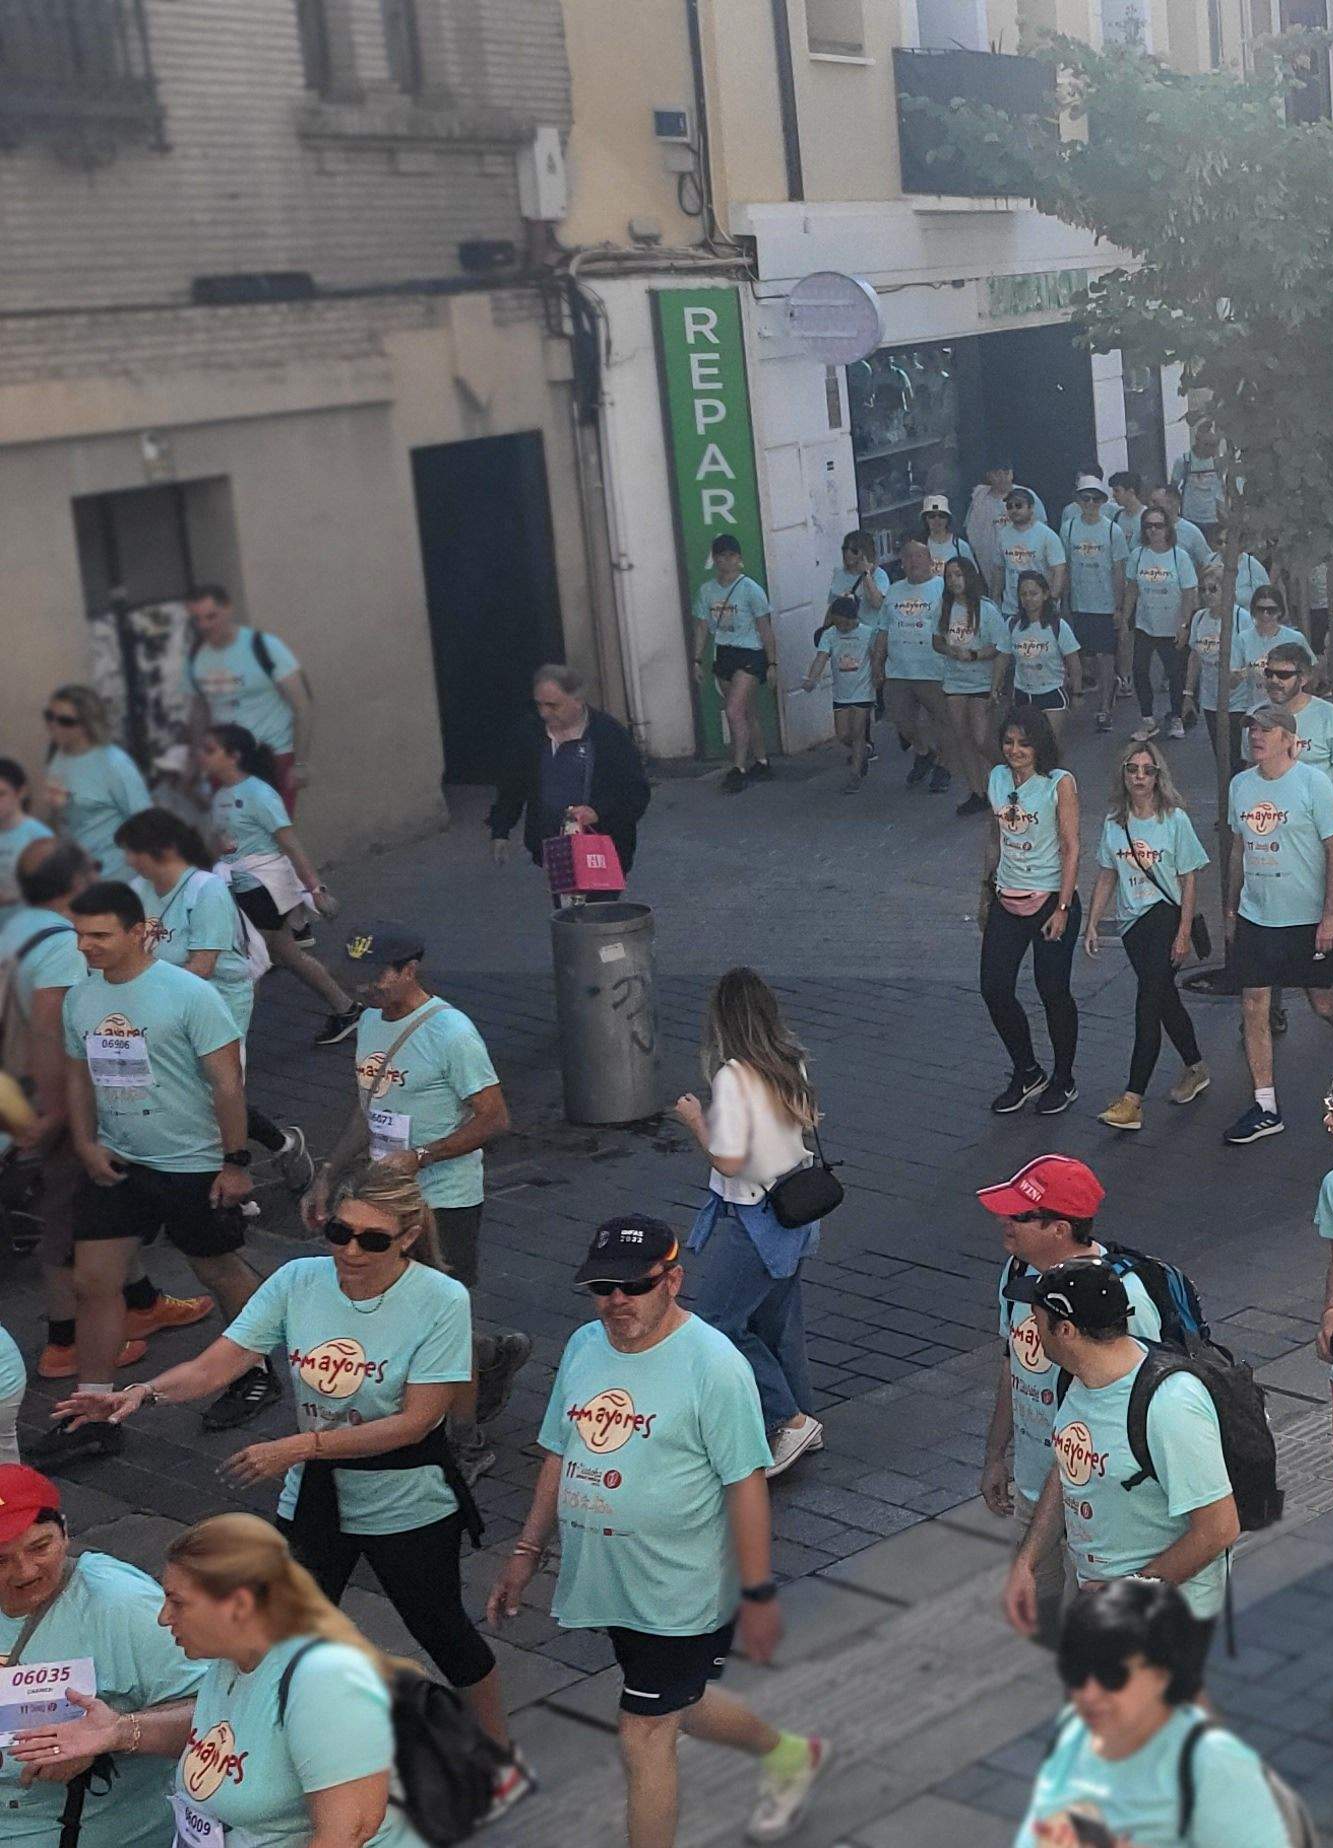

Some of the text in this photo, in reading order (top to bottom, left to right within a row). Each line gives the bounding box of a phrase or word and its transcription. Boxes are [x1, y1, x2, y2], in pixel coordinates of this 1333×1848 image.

[683, 306, 738, 571] REPAR
[1240, 809, 1288, 827] +mayores
[289, 1349, 389, 1384] +mayores
[567, 1406, 657, 1438] +mayores
[567, 1461, 577, 1478] 11
[12, 1666, 71, 1686] 06035
